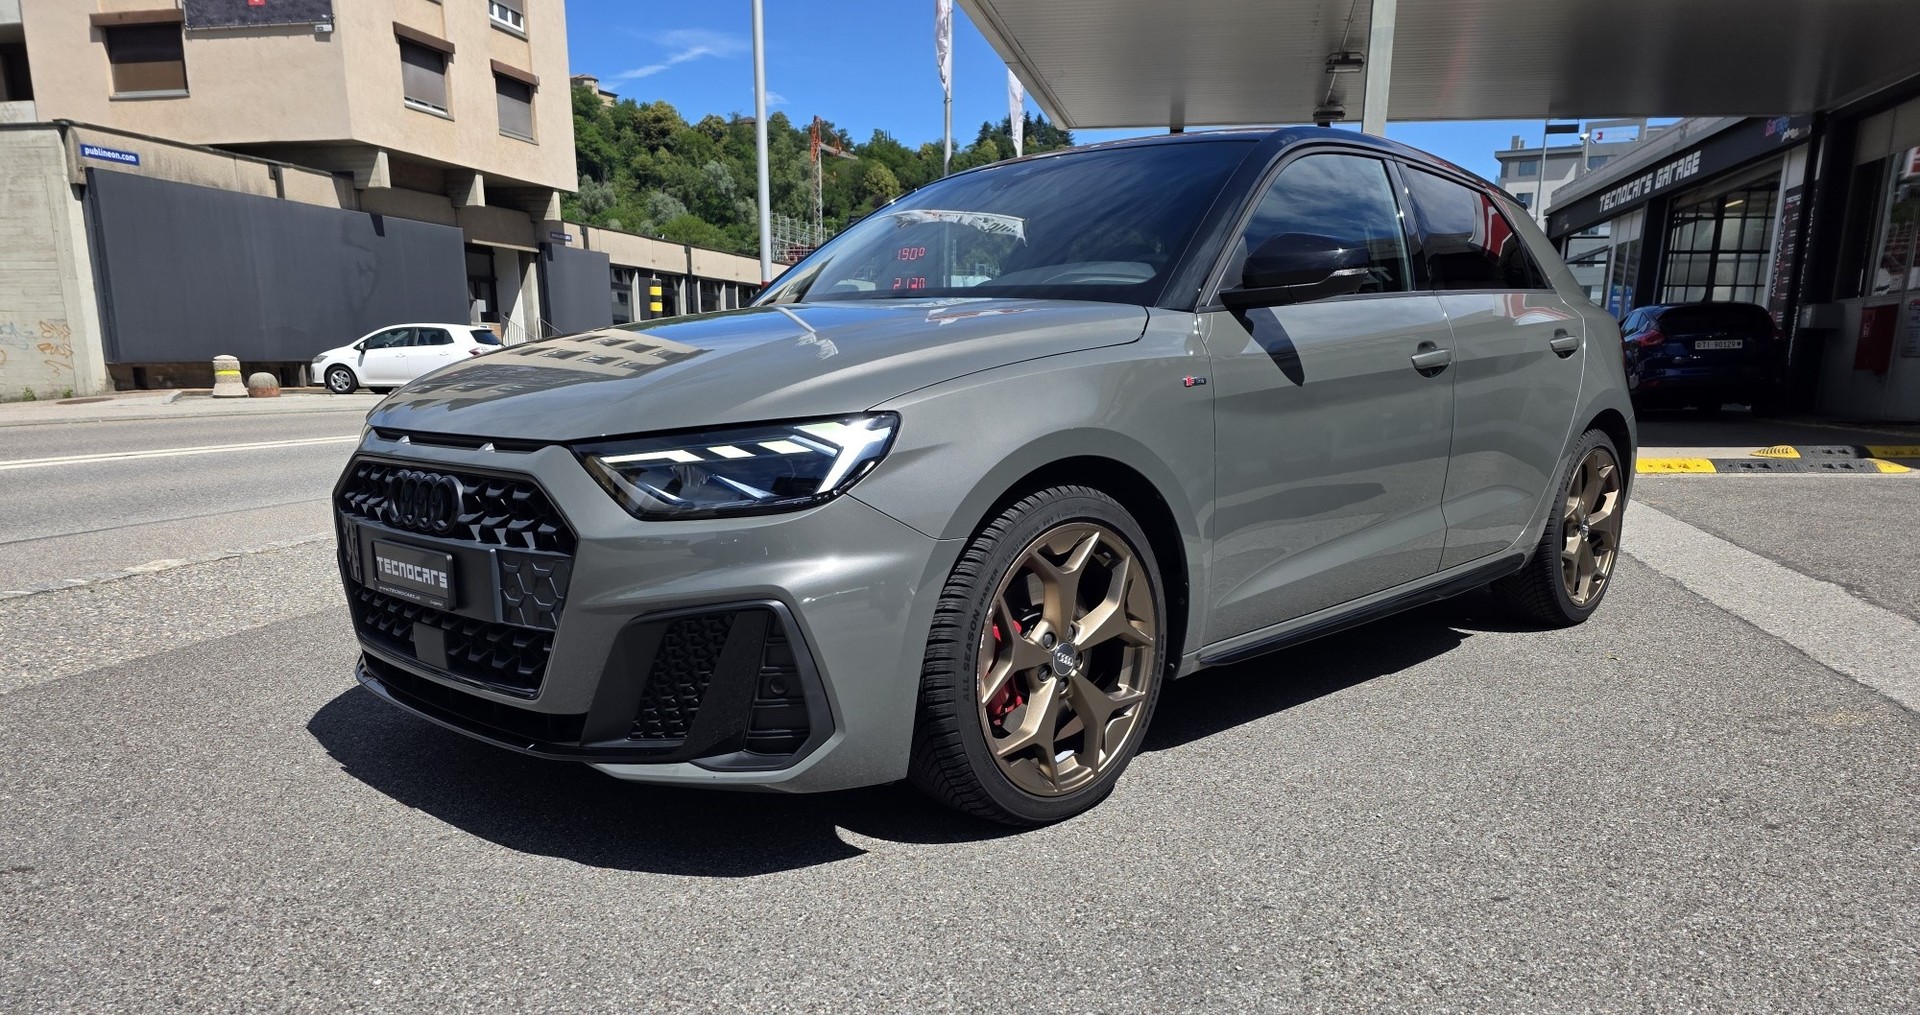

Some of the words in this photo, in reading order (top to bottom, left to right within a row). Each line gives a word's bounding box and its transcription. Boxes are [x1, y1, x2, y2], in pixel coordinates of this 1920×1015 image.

[84, 147, 137, 162] publineon.com
[376, 556, 449, 589] TECNOCARS
[979, 568, 999, 608] MASTER
[963, 608, 981, 673] SEASON
[962, 676, 971, 703] ALL
